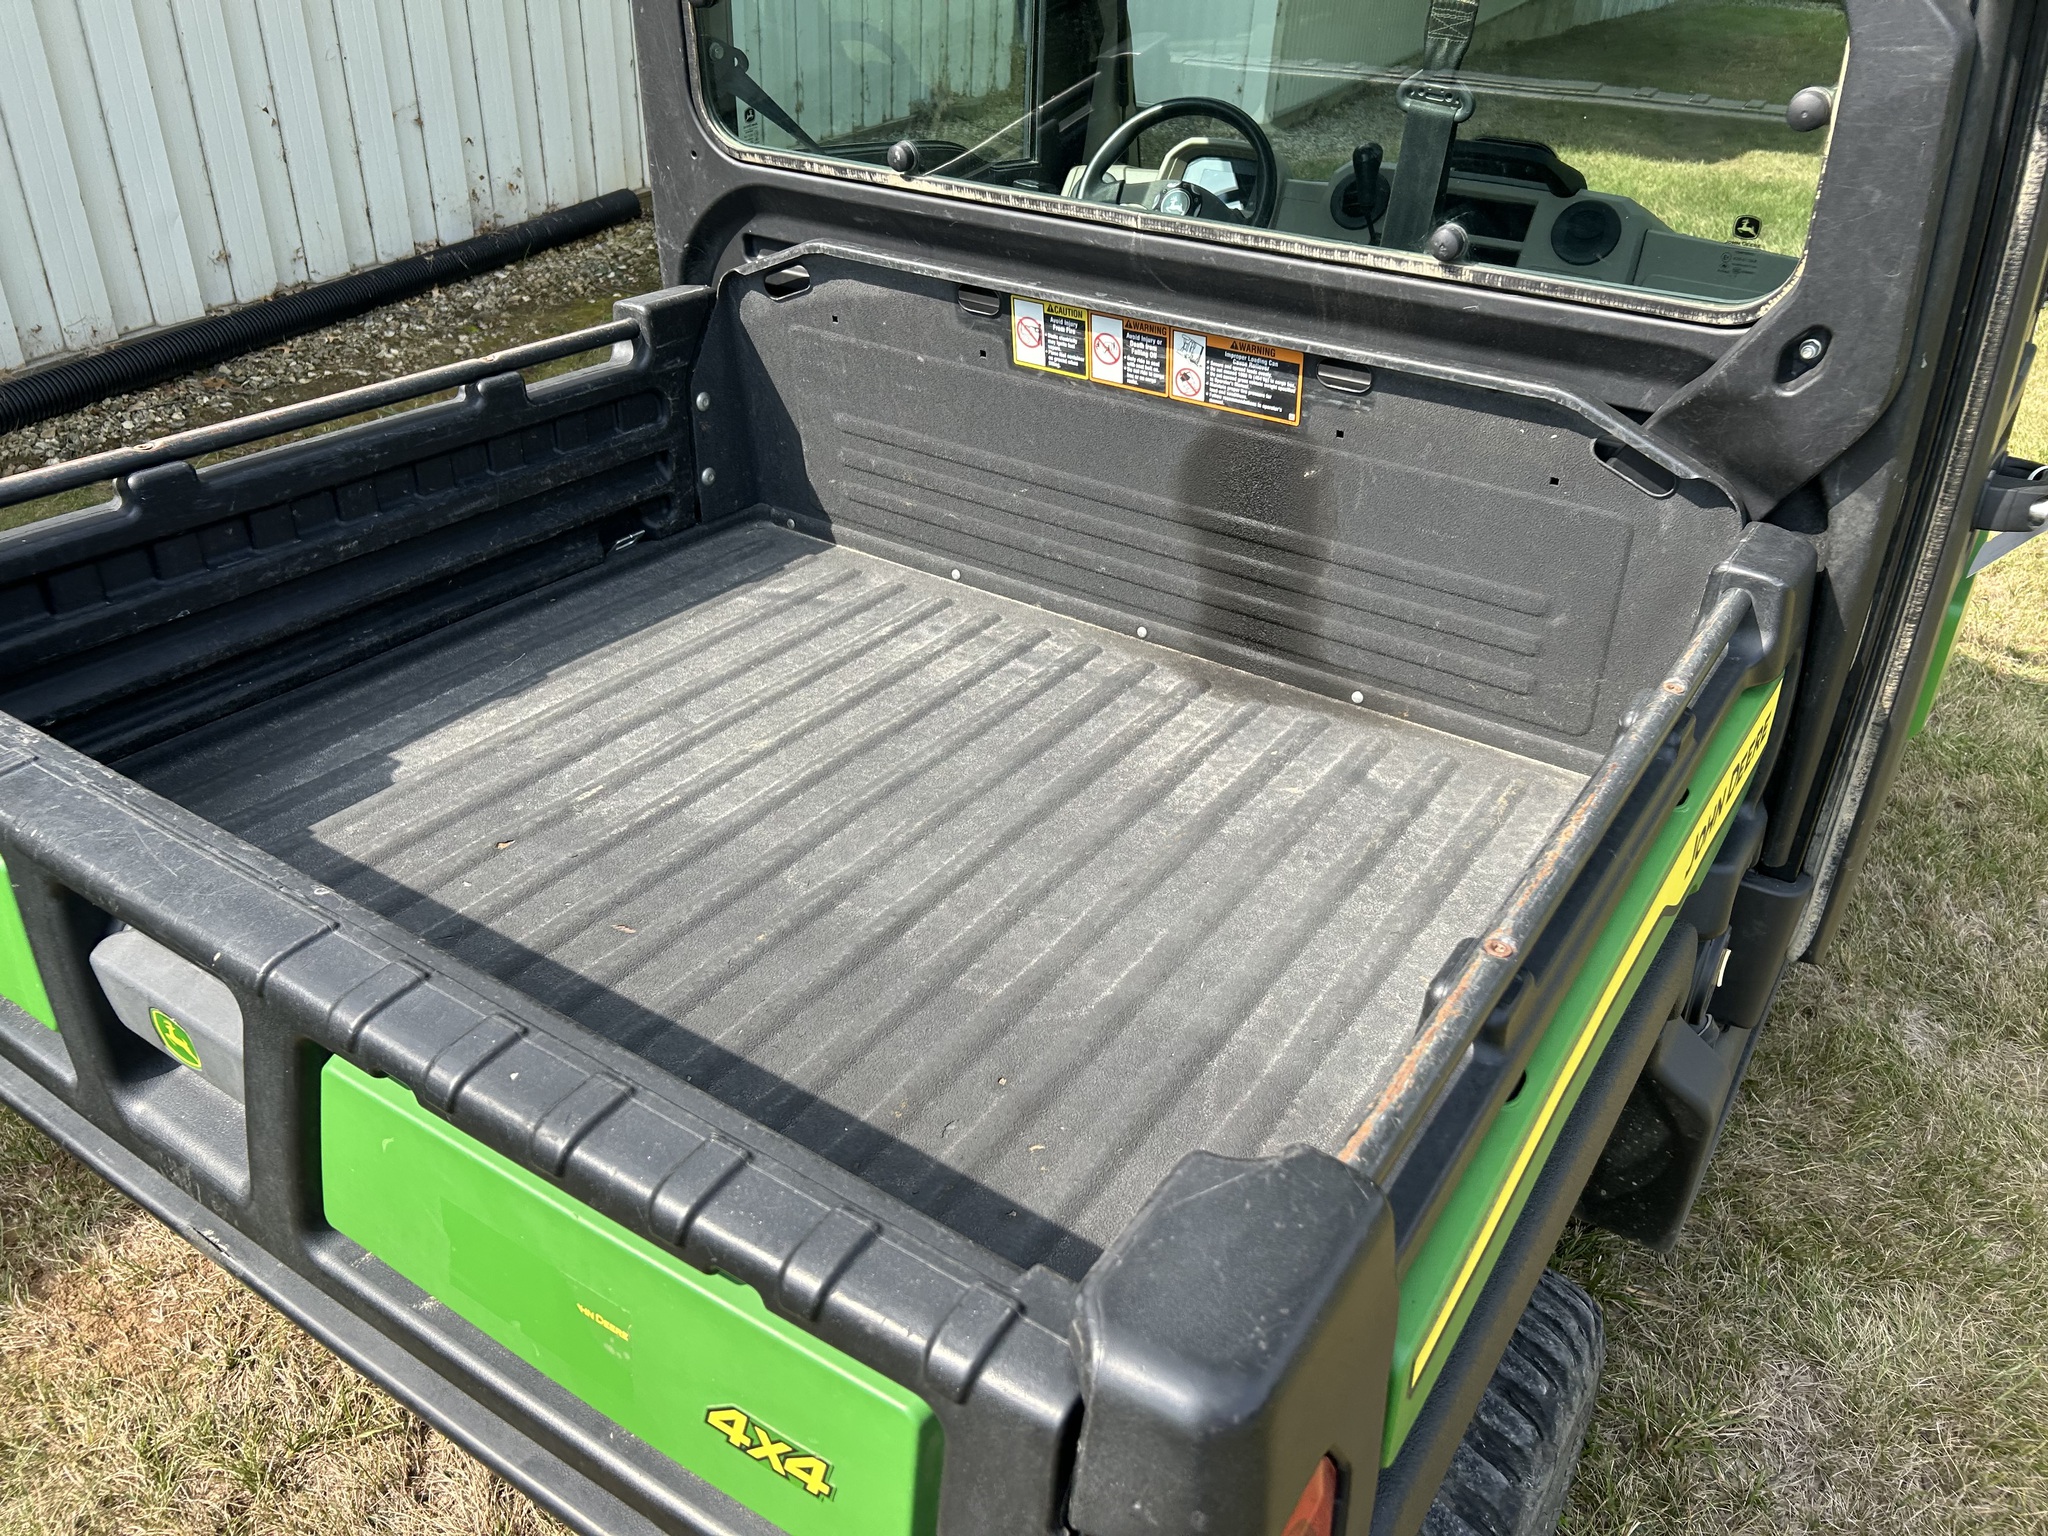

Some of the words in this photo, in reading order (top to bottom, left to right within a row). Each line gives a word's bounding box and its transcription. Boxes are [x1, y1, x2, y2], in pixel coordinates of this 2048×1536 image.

[1054, 305, 1082, 318] CAUTION
[1050, 317, 1063, 325] Avoid
[1064, 319, 1078, 328] Injury
[1053, 324, 1064, 332] From
[1133, 321, 1167, 335] WARNING
[1130, 340, 1144, 348] Death
[1146, 343, 1157, 351] from
[1141, 336, 1155, 345] Injury
[1239, 342, 1275, 357] WARNING
[1225, 351, 1246, 360] Improper
[1248, 356, 1267, 365] Loading
[1684, 787, 1727, 880] JOHN
[1724, 711, 1772, 804] DEERE
[705, 1406, 834, 1498] 4X4
